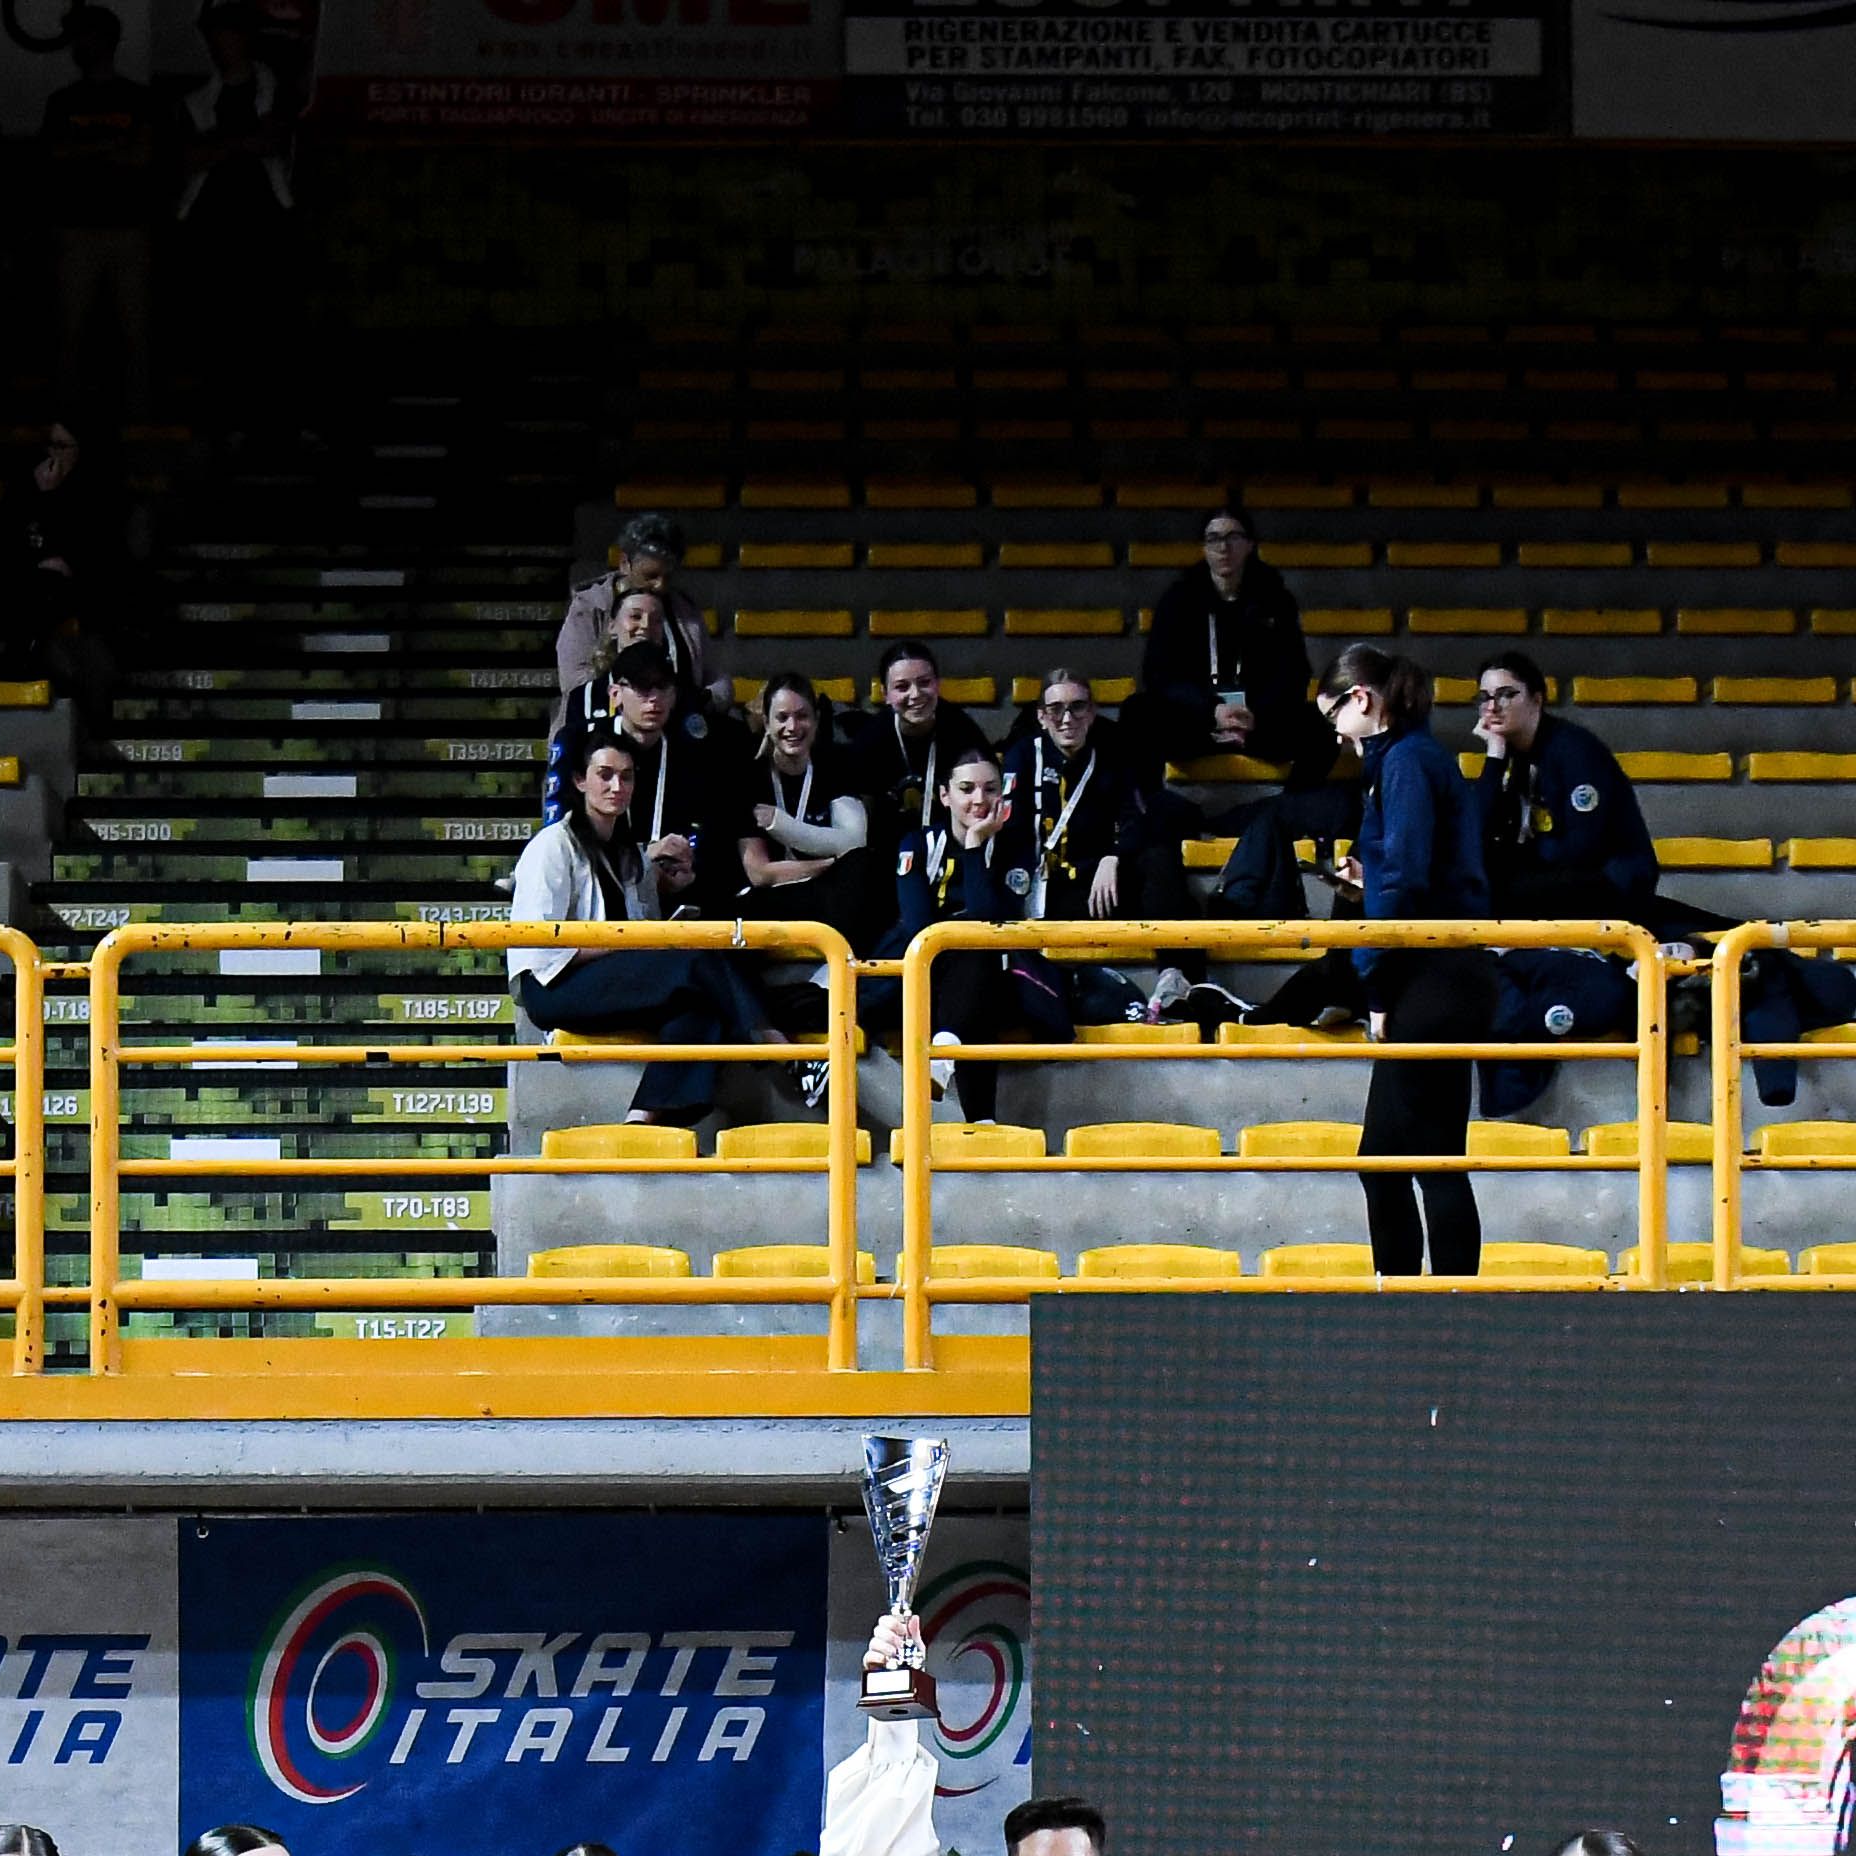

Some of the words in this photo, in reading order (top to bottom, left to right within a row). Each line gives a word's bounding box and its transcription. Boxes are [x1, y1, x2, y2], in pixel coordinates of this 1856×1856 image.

[905, 20, 1154, 43] RIGENERAZIONE
[1164, 20, 1181, 43] E
[1193, 20, 1320, 43] VENDITA
[1331, 20, 1492, 43] CARTUCCE
[907, 46, 968, 69] PER
[1248, 46, 1490, 70] FOTOCOPIATORI
[367, 82, 513, 103] ESTINTORI
[656, 84, 813, 105] SPRINKLER
[118, 744, 183, 761] 3-T358
[90, 823, 172, 841] 85-T300
[444, 823, 533, 841] T301-T313
[58, 908, 131, 928] 27-T242
[402, 1000, 501, 1020] T185-T197
[392, 1092, 494, 1115] T127-T139
[382, 1197, 471, 1219] T70-T83
[356, 1319, 447, 1340] T15-T27
[415, 1630, 796, 1699] SKATE
[390, 1707, 767, 1764] ITALIA
